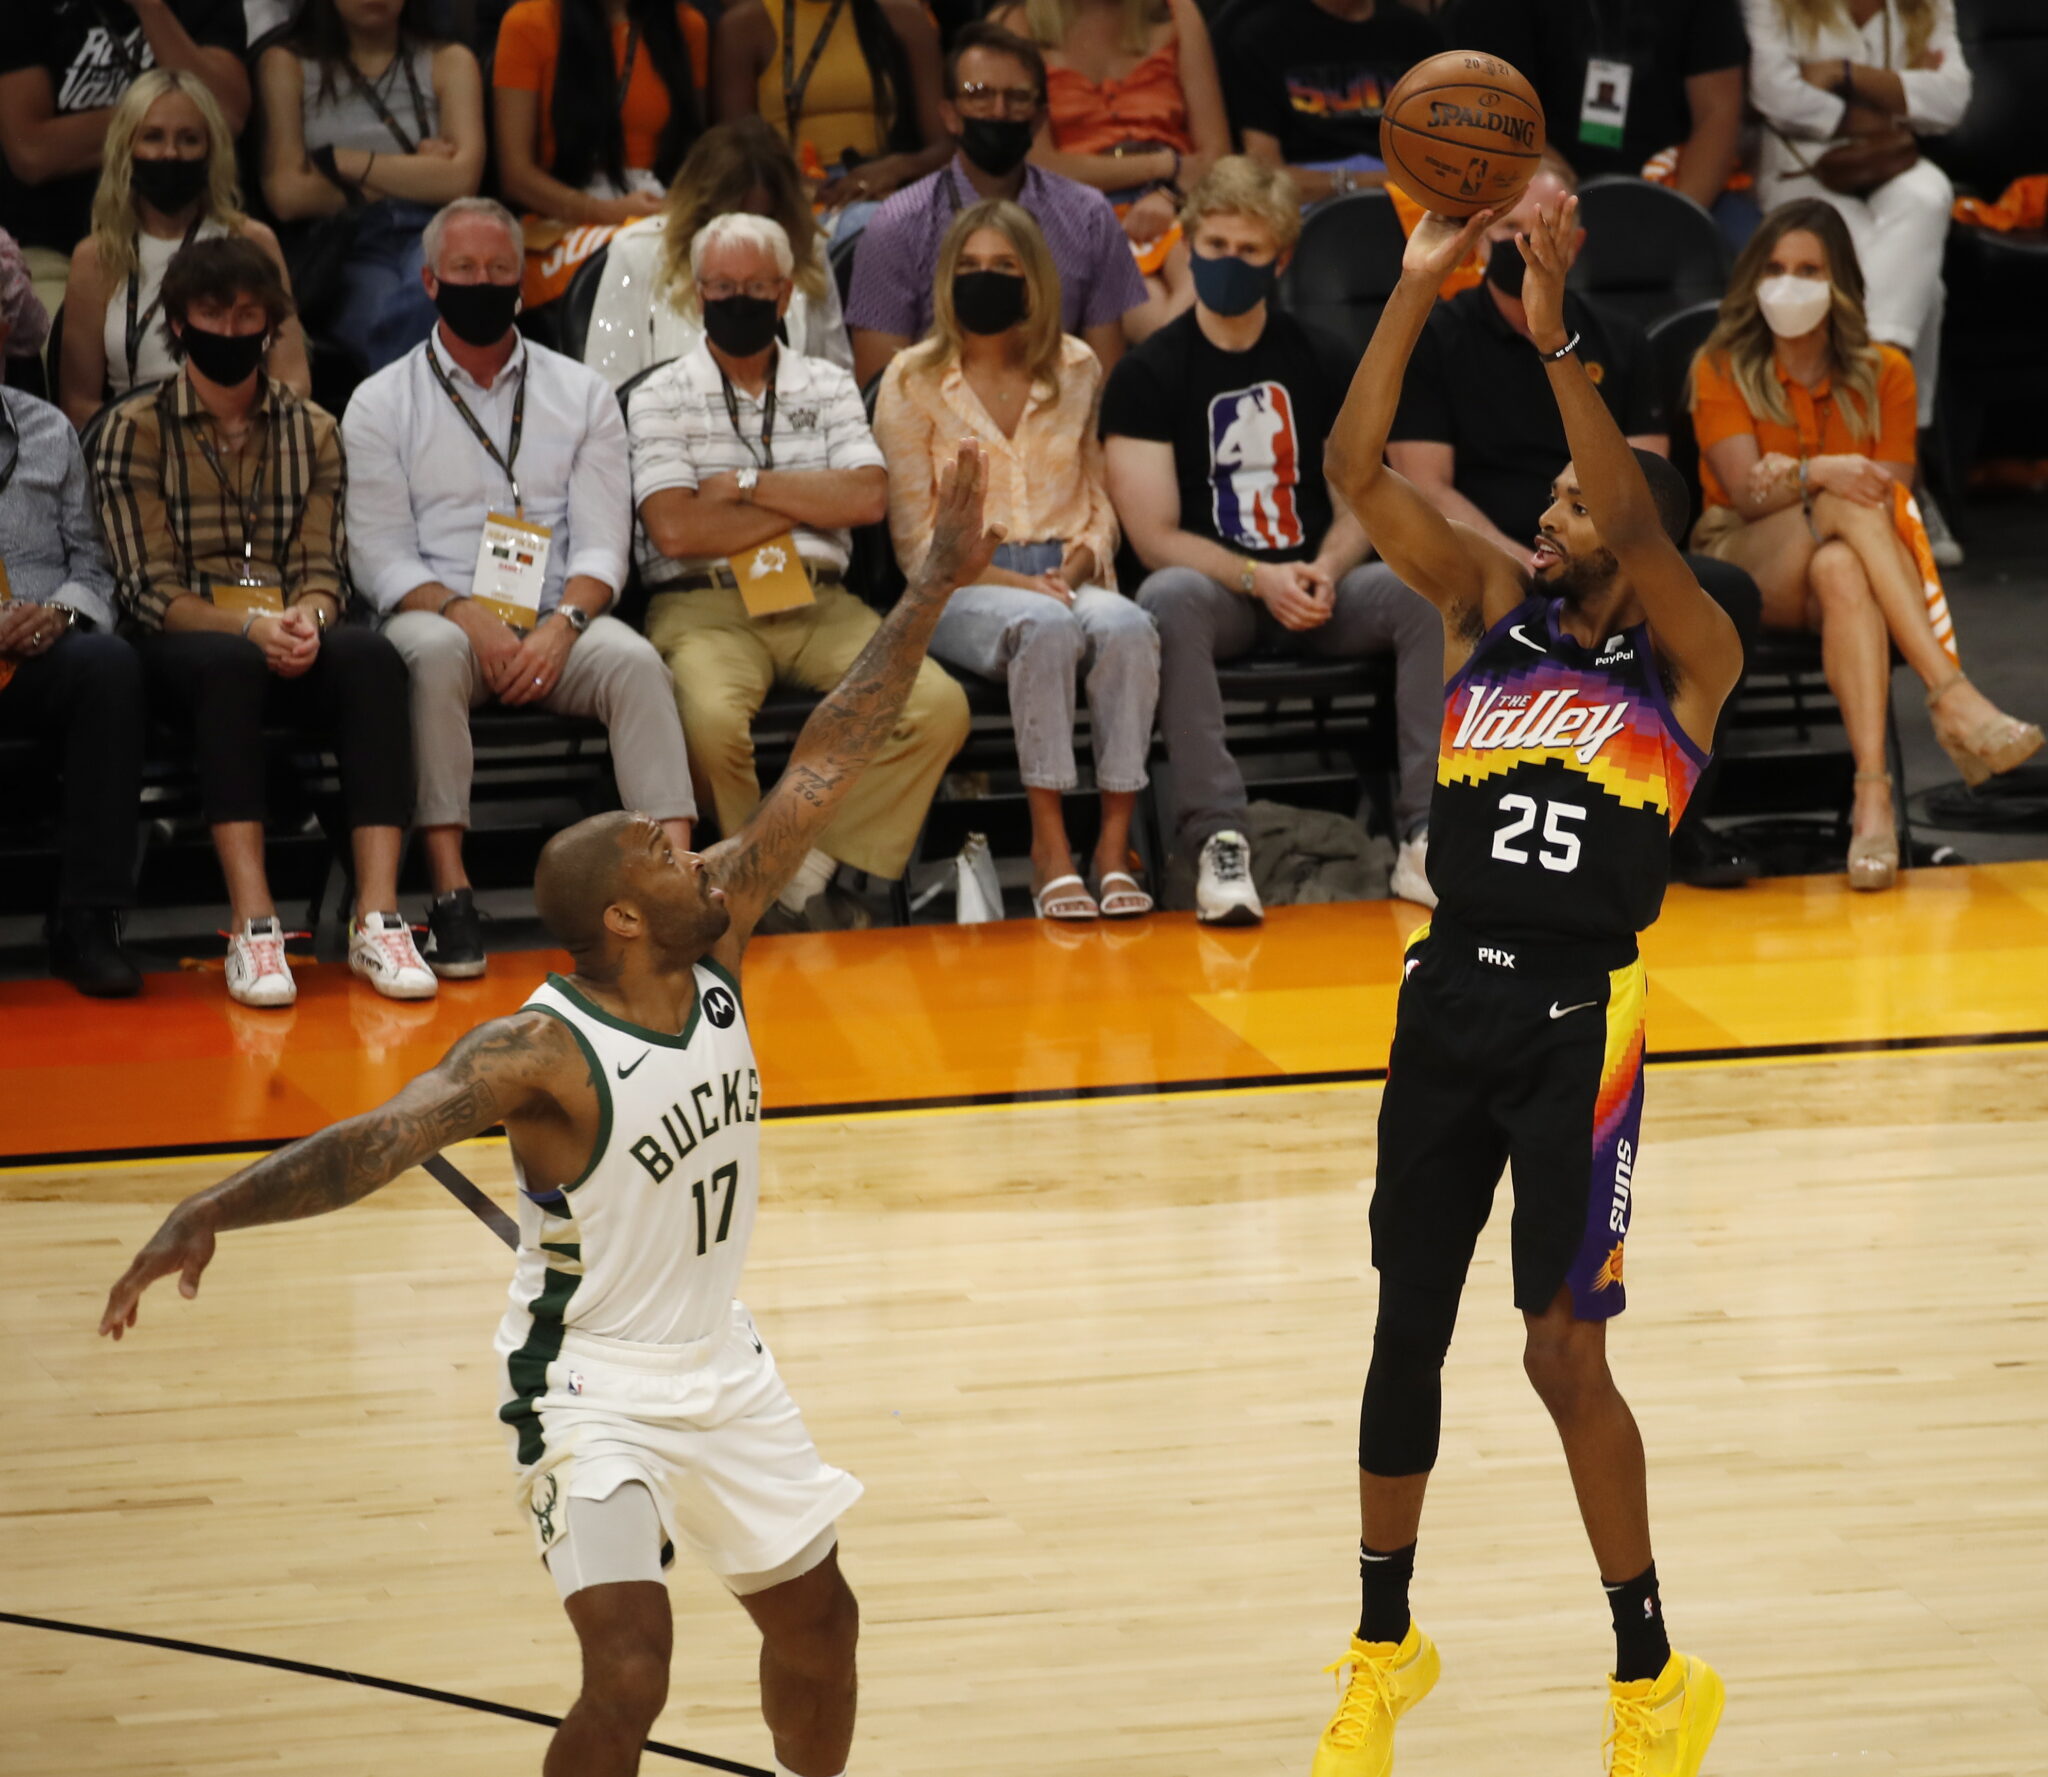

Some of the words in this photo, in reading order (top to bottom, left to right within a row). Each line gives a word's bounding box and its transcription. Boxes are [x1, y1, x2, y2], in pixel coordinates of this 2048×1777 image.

[1427, 101, 1535, 150] SPALDING
[1595, 650, 1634, 666] PayPal
[1452, 685, 1629, 764] Valley
[1498, 695, 1532, 707] THE
[1491, 793, 1587, 873] 25
[1478, 947, 1515, 969] PHX
[629, 1068, 759, 1184] BUCKS
[692, 1160, 738, 1256] 17
